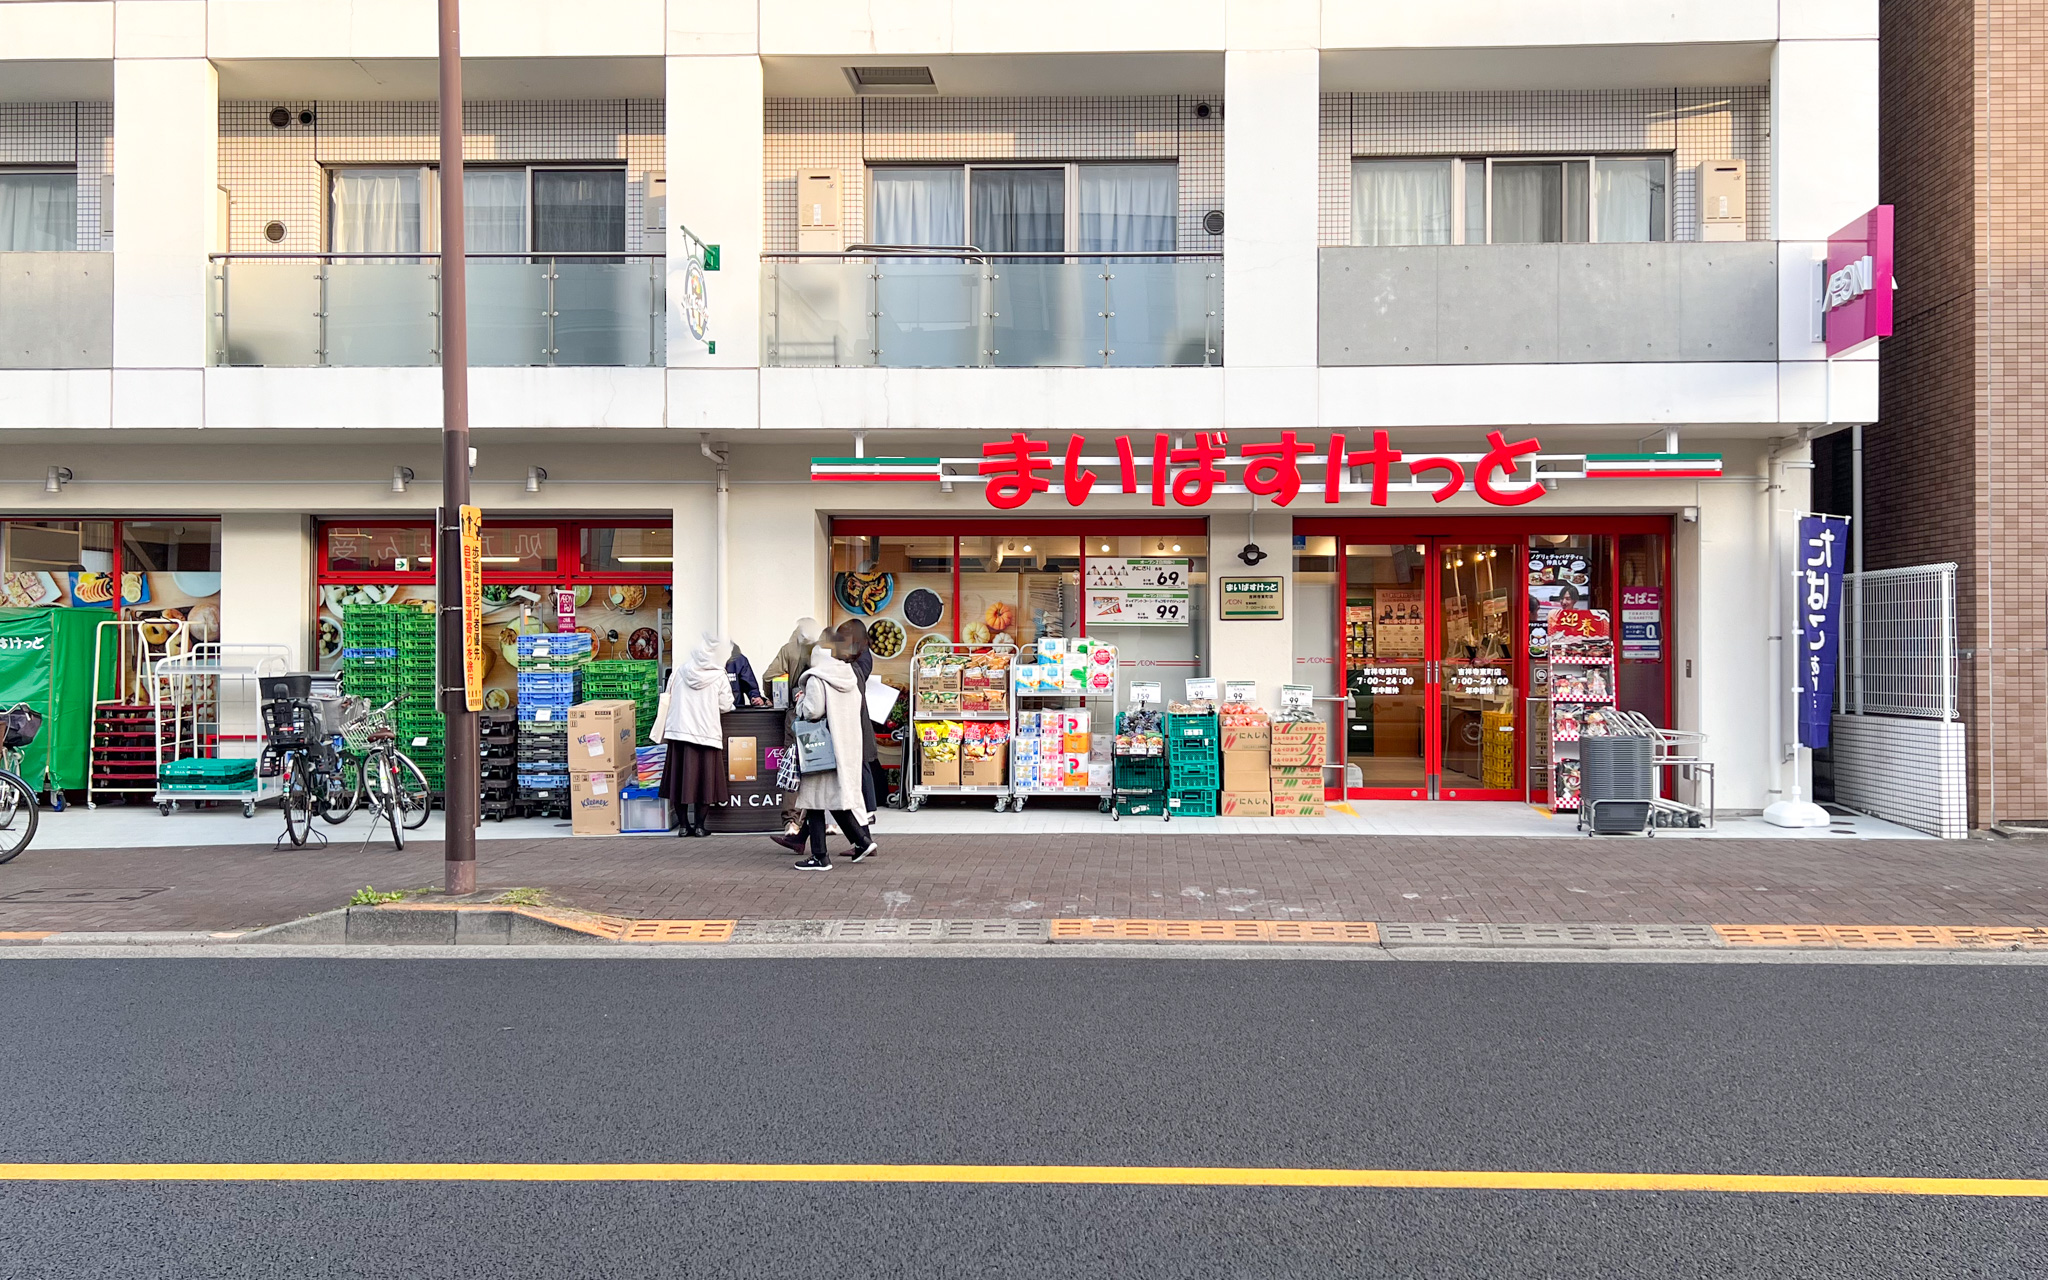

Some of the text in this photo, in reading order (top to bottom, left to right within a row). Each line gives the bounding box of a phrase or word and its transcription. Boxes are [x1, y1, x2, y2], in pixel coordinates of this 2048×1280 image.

[979, 430, 1547, 510] まいばすけっと
[1157, 571, 1179, 586] 69
[1226, 583, 1278, 592] まいばすけっと
[472, 546, 480, 660] 歩道は歩行者優先
[1623, 592, 1658, 604] たばこ
[1156, 605, 1179, 619] 99
[1560, 611, 1596, 638] 迎春
[1233, 692, 1243, 700] 99
[580, 798, 608, 808] Kleenex
